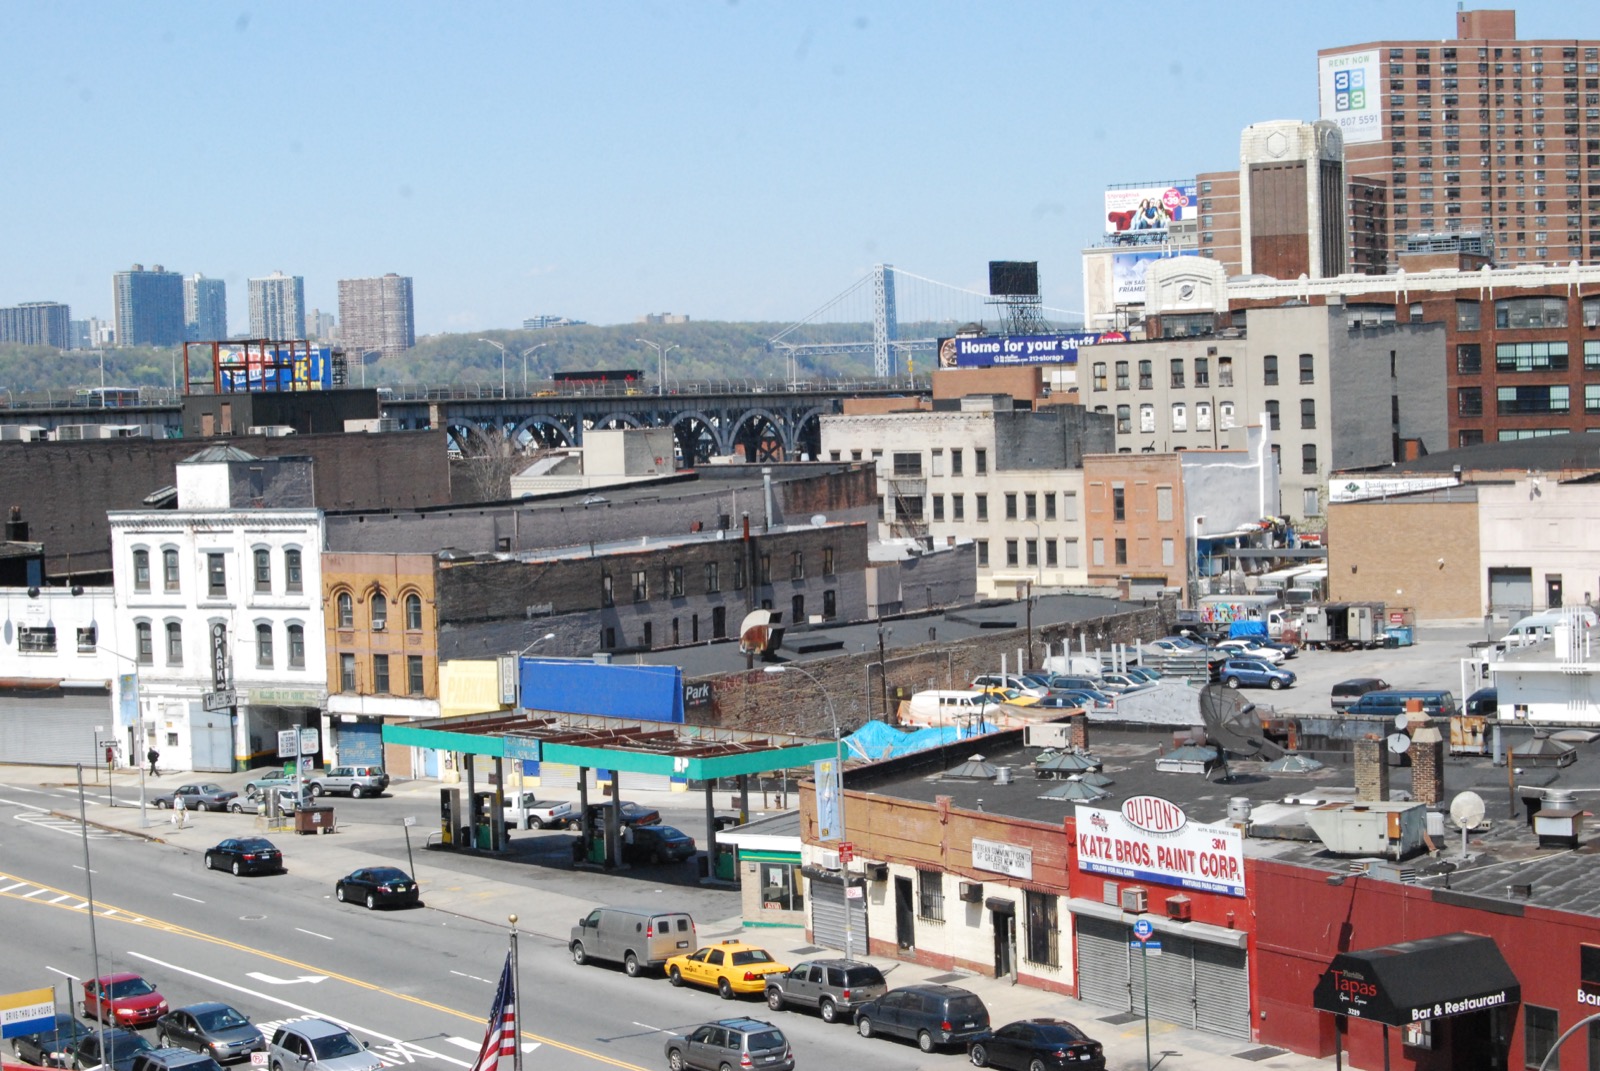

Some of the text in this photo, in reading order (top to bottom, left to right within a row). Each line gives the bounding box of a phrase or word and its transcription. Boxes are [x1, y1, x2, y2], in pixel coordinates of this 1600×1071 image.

[1328, 56, 1370, 68] RENT NOW
[1340, 117, 1356, 126] 807
[1358, 115, 1378, 124] 5591
[962, 336, 1095, 355] Home for your stuff
[214, 637, 225, 681] PARK
[686, 683, 709, 700] Park
[1126, 798, 1181, 832] DUPONT
[992, 846, 1015, 858] COMMUNITY
[1212, 838, 1227, 850] 3M
[985, 853, 1002, 864] GREATER
[1004, 858, 1012, 866] NEW
[1014, 860, 1024, 868] YORK
[1080, 833, 1242, 882] KATZ BROS. PAINT CORP.
[1092, 863, 1108, 873] COLORS
[1108, 866, 1116, 874] FOR
[1116, 868, 1124, 876] ALL
[1124, 868, 1134, 877] CARS
[1331, 970, 1377, 1002] Tapas
[1412, 991, 1506, 1021] Bar & Restaurant
[1577, 989, 1600, 1007] Bar
